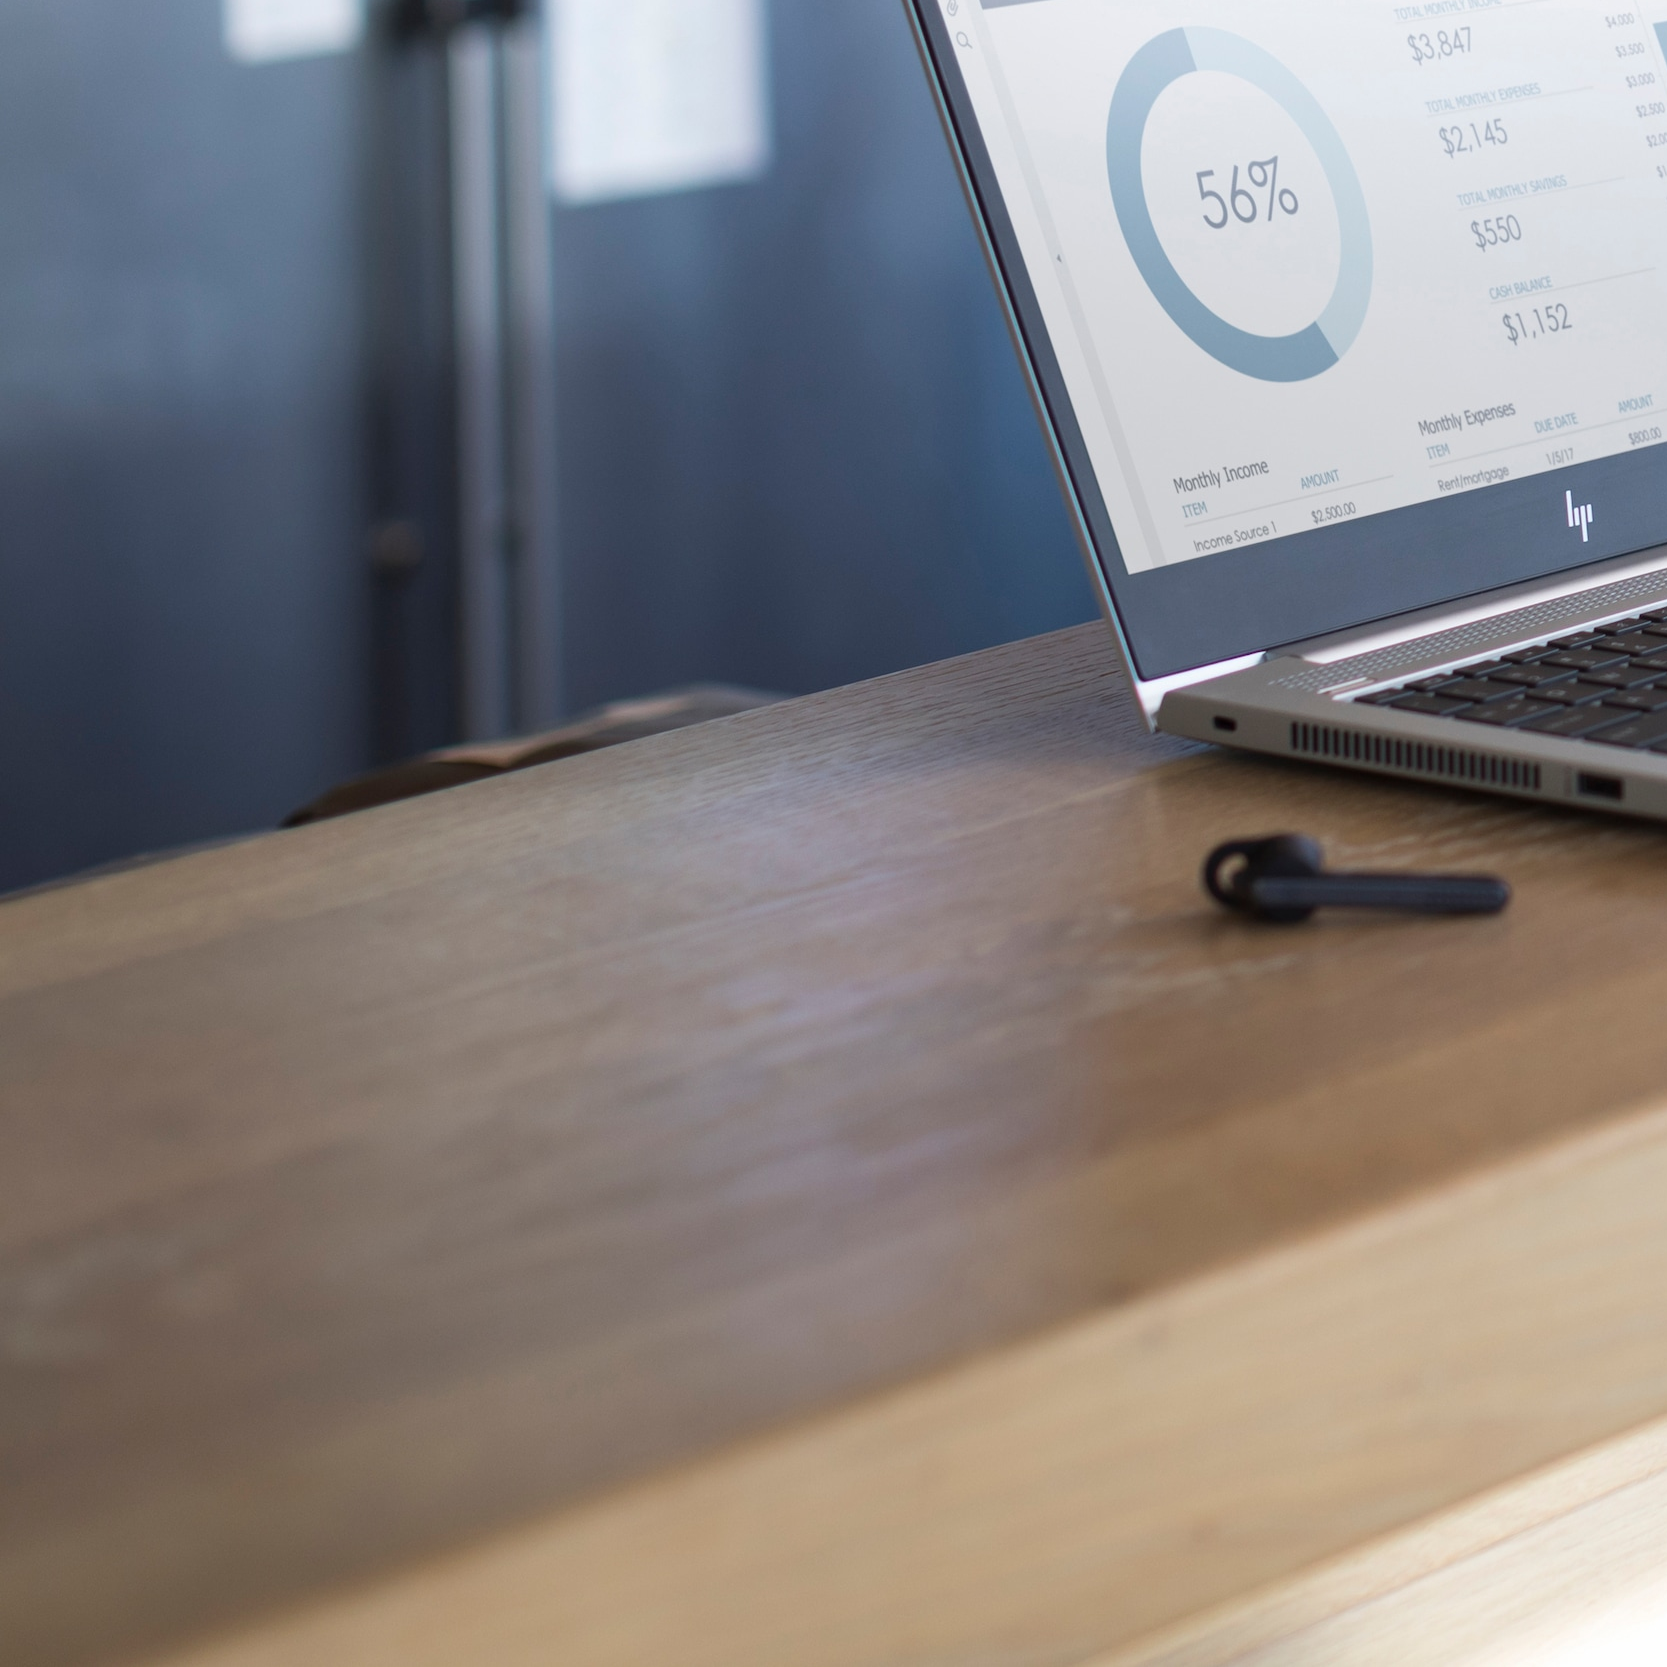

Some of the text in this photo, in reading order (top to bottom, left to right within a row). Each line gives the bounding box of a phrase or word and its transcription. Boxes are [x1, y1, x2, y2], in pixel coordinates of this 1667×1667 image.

[1393, 6, 1424, 21] TOTAL
[1407, 26, 1472, 66] $3,847
[1425, 82, 1542, 113] TOTAL MONTHLY EXPENSES
[1438, 117, 1508, 159] $2,145
[1196, 156, 1299, 230] 56%
[1456, 174, 1568, 206] TOTAL MONTHLY SAVINGS
[1470, 214, 1522, 253] $550
[1489, 275, 1553, 300] CASH BALANCE
[1502, 303, 1572, 346] $1,152
[1618, 394, 1653, 414] AMOUNT
[1418, 402, 1516, 436] Monthly Expenses
[1533, 412, 1579, 434] DUE DATE
[1628, 426, 1662, 446] $800.00
[1426, 442, 1451, 460] ITEM
[1546, 447, 1574, 466] 1/5/17
[1173, 460, 1270, 494] Monthly Income
[1301, 469, 1340, 490] AMOUNT
[1437, 465, 1510, 492] Rent/mortgage
[1182, 500, 1208, 518] ITEM
[1311, 501, 1356, 524] $2,500.00
[1193, 520, 1277, 552] Income Source 1
